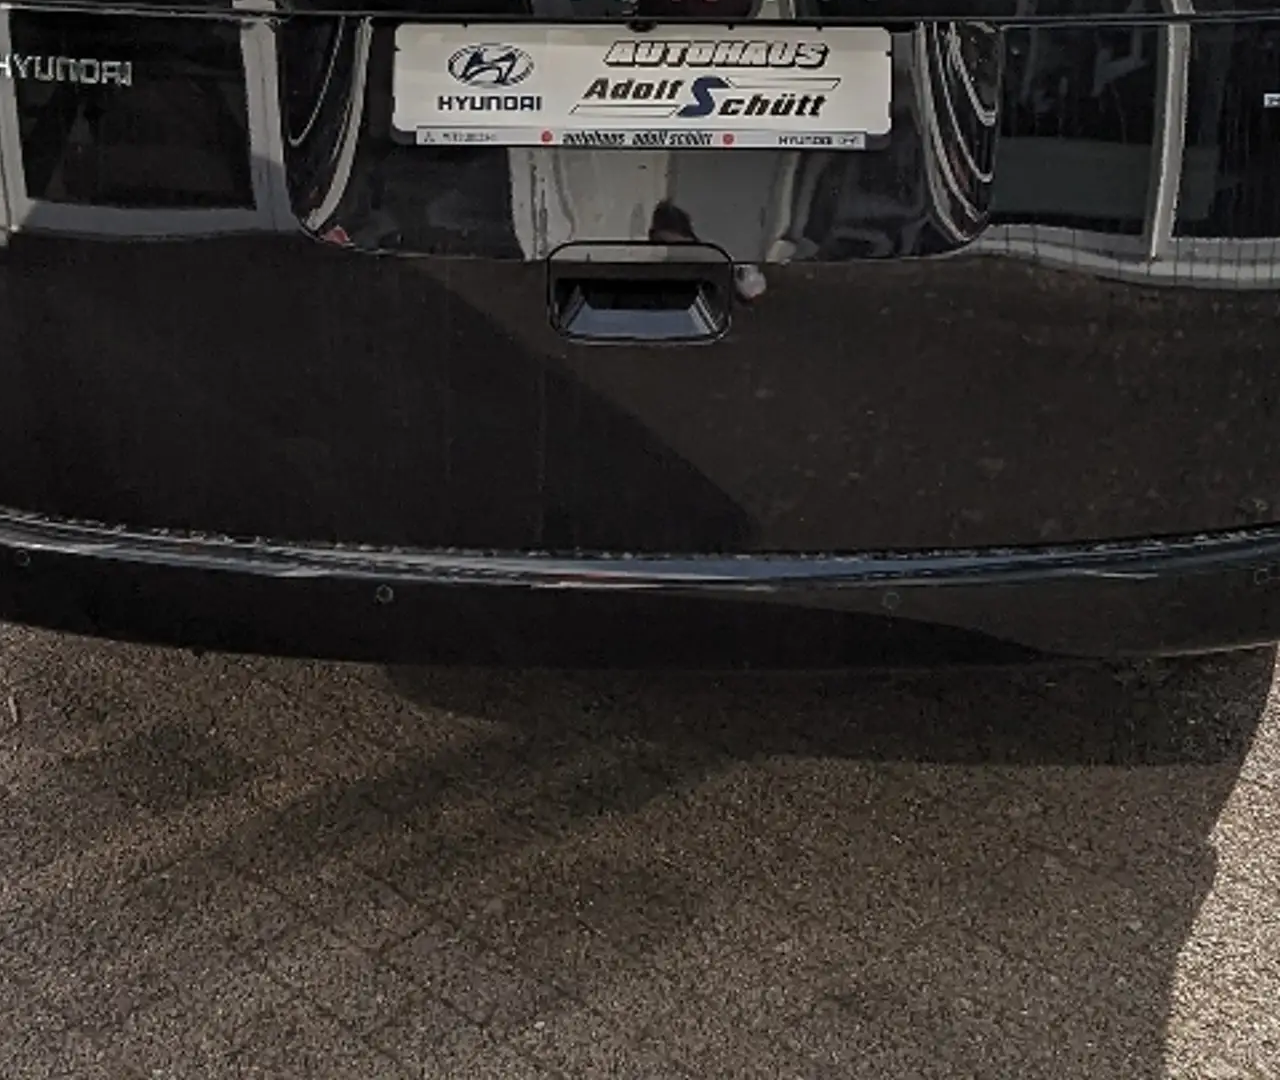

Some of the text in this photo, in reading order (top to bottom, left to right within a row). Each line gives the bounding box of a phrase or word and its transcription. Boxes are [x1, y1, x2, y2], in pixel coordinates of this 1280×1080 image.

[603, 40, 829, 68] AUTOHAUS
[437, 95, 541, 112] HYUNDAI
[581, 75, 826, 118] Adolf Schütt
